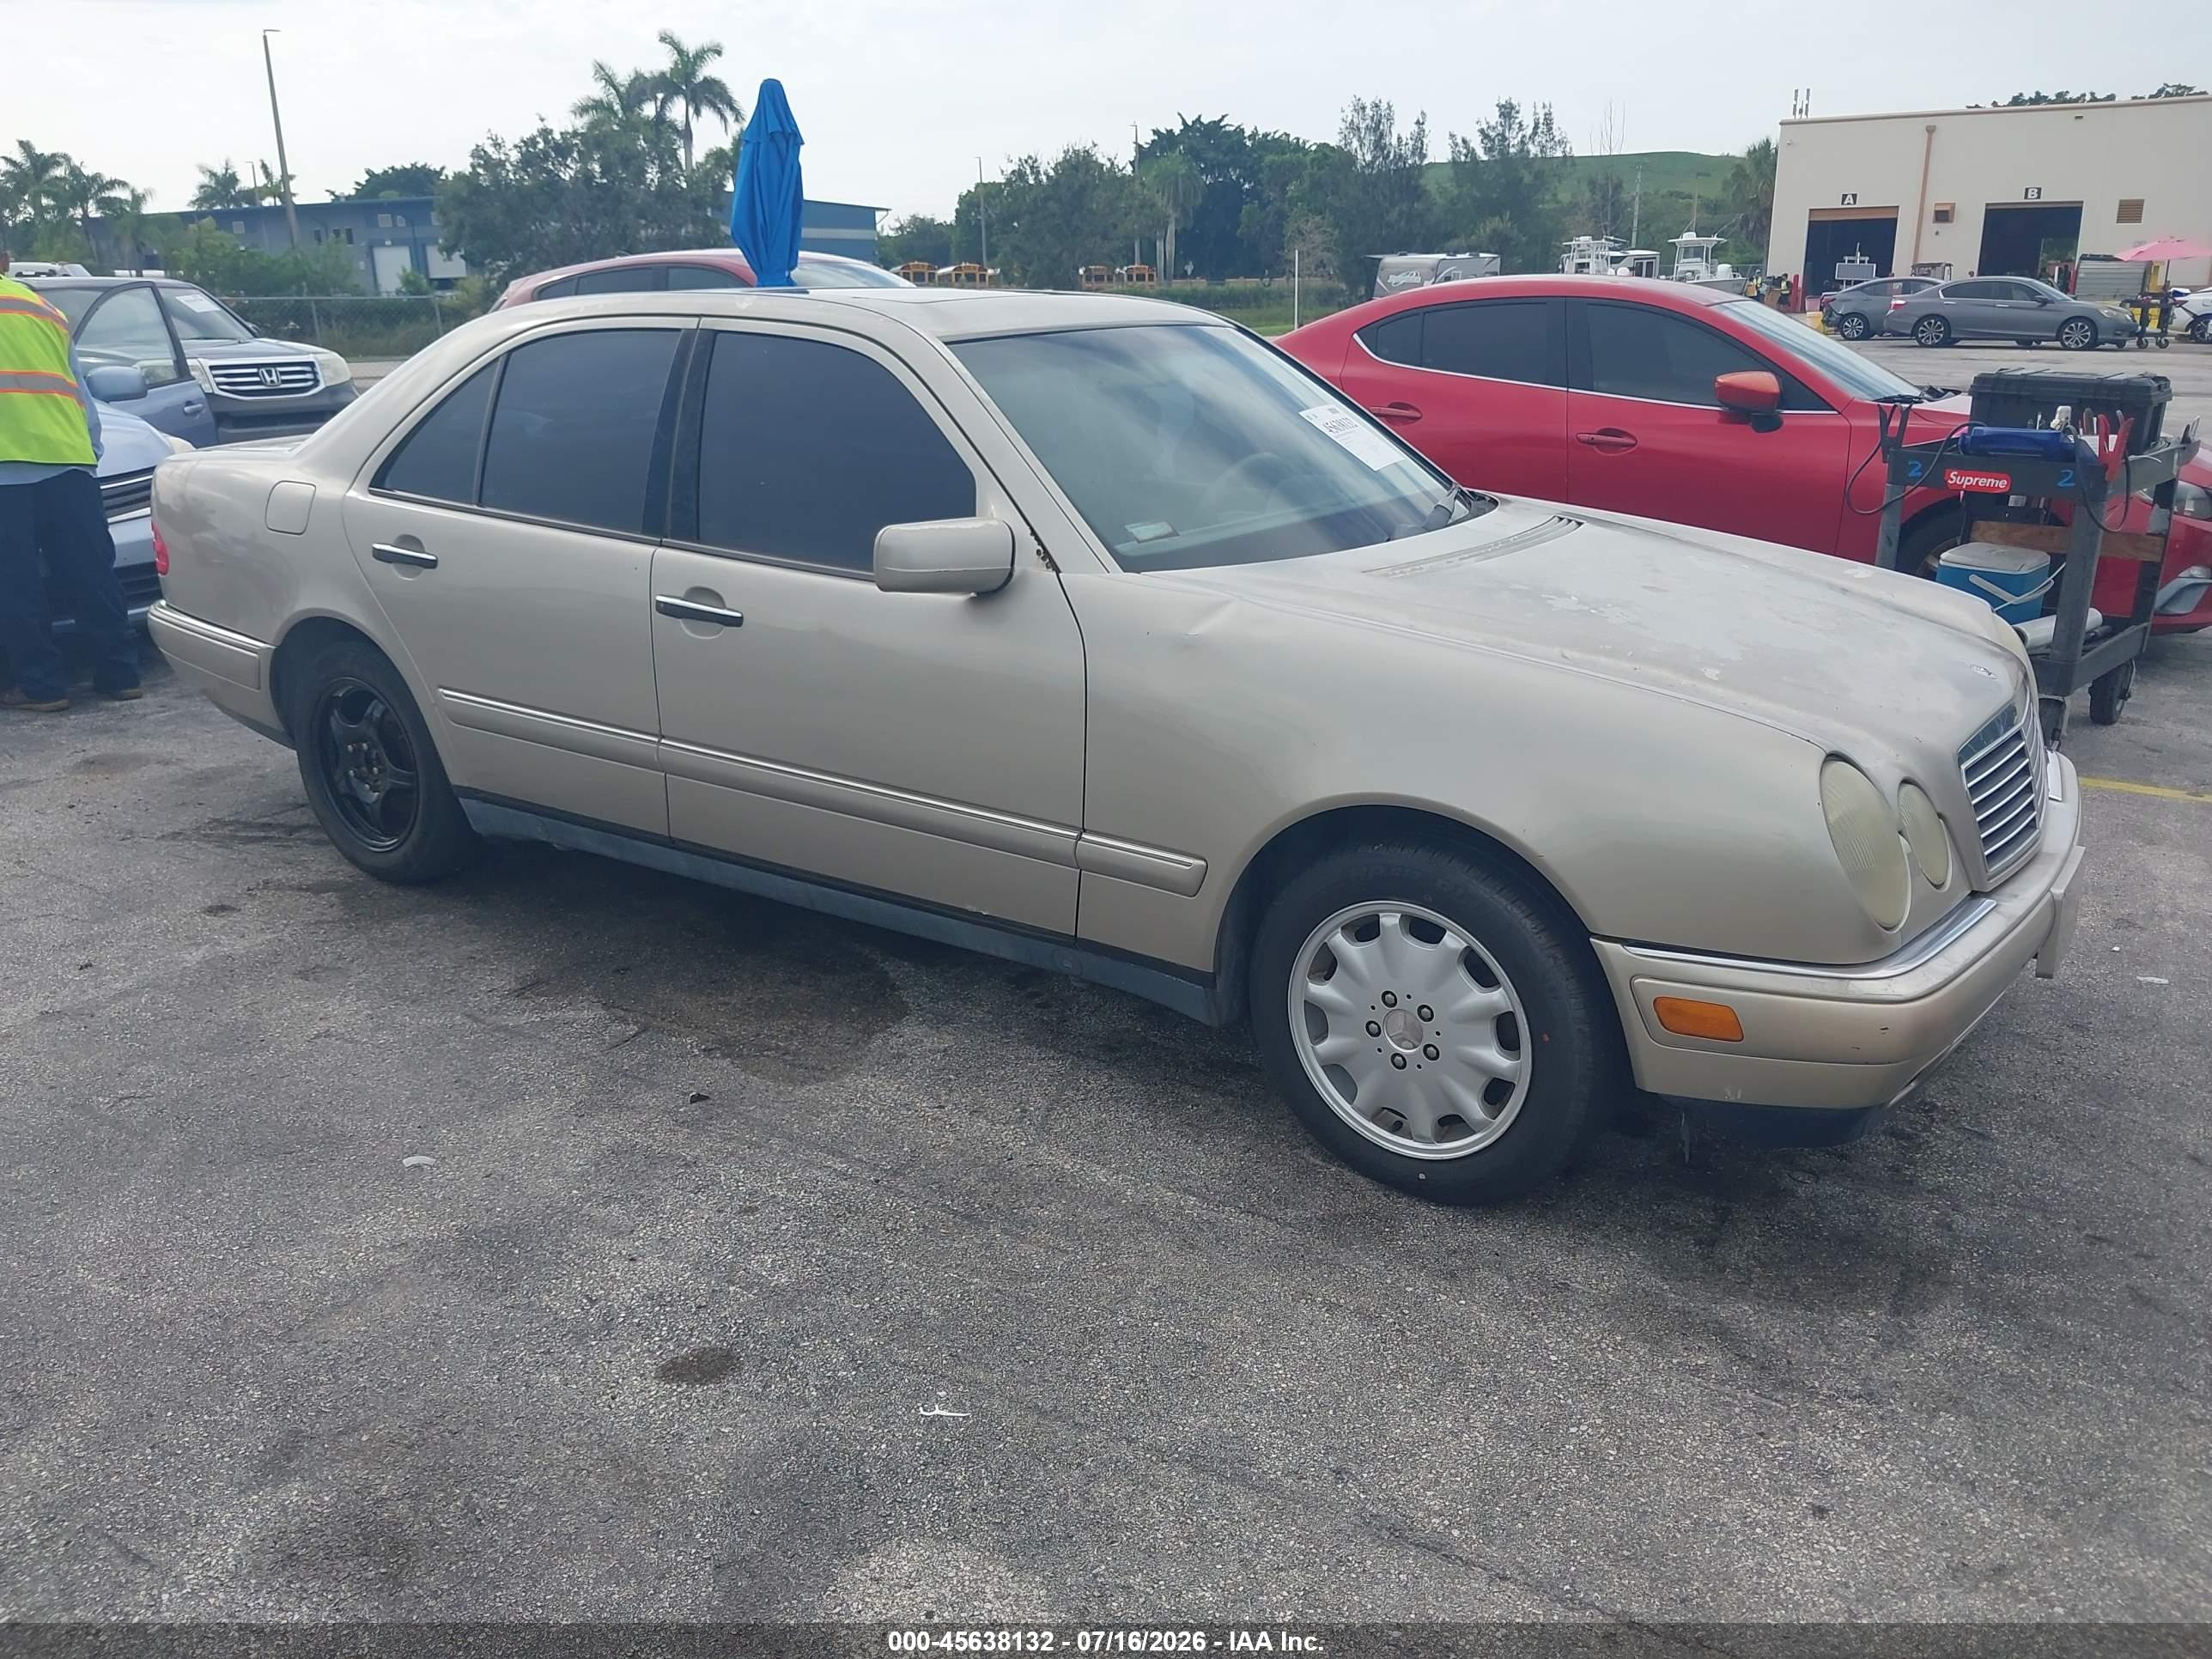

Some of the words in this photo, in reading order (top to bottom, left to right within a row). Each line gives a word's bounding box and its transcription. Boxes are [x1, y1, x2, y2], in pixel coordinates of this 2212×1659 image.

[1844, 194, 1855, 204] A
[2027, 188, 2039, 198] B
[1908, 461, 1922, 477] 2
[1948, 471, 2008, 489] Supreme
[2057, 469, 2075, 488] 2
